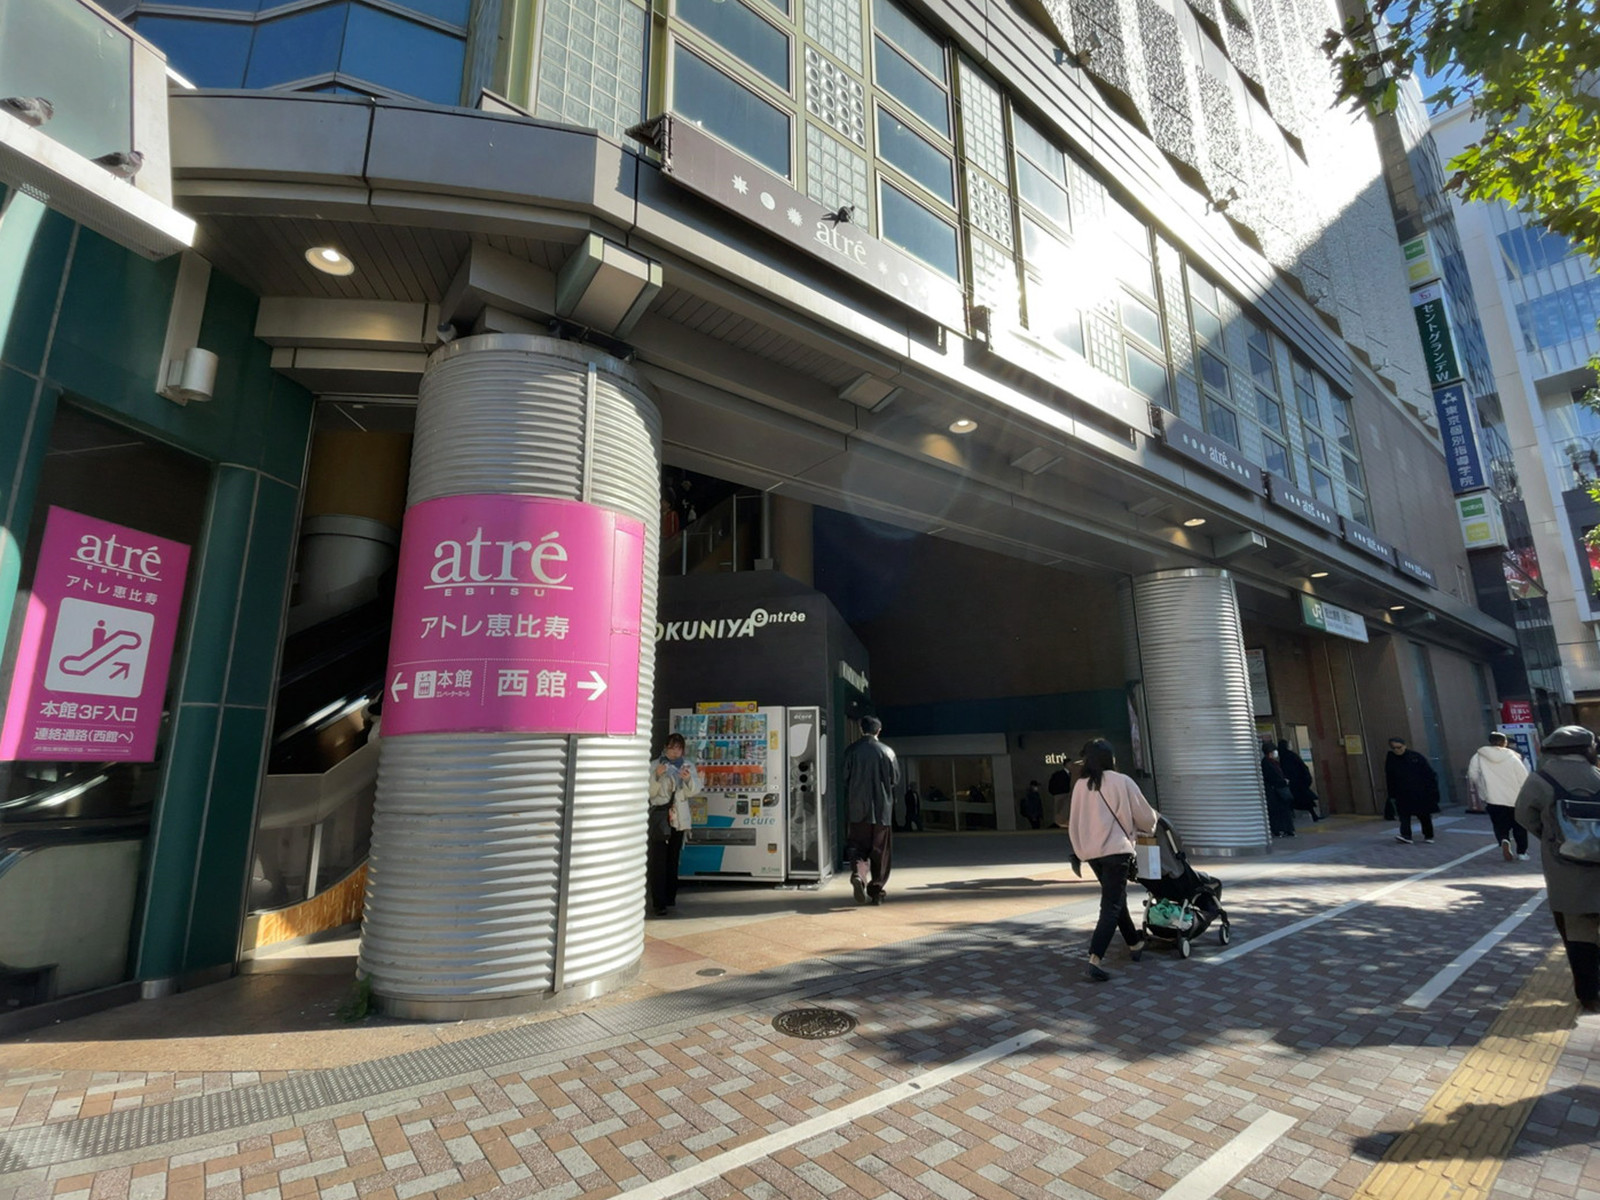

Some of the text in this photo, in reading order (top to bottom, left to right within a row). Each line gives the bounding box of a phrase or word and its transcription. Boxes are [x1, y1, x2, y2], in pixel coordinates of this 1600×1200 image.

[816, 221, 867, 266] atré
[1421, 303, 1449, 384] セントグランデW
[1444, 405, 1475, 488] 東京個別指導学院
[76, 533, 162, 577] atré
[430, 527, 568, 585] atré
[65, 574, 159, 606] アトレ恵比寿
[444, 586, 545, 597] EBISU
[420, 613, 570, 641] アトレ恵比寿
[437, 669, 473, 689] 本館
[497, 669, 568, 699] 西館
[39, 700, 138, 723] 本館3F入口
[33, 727, 135, 744] 連絡通路(西館へ)
[742, 816, 776, 826] acure
